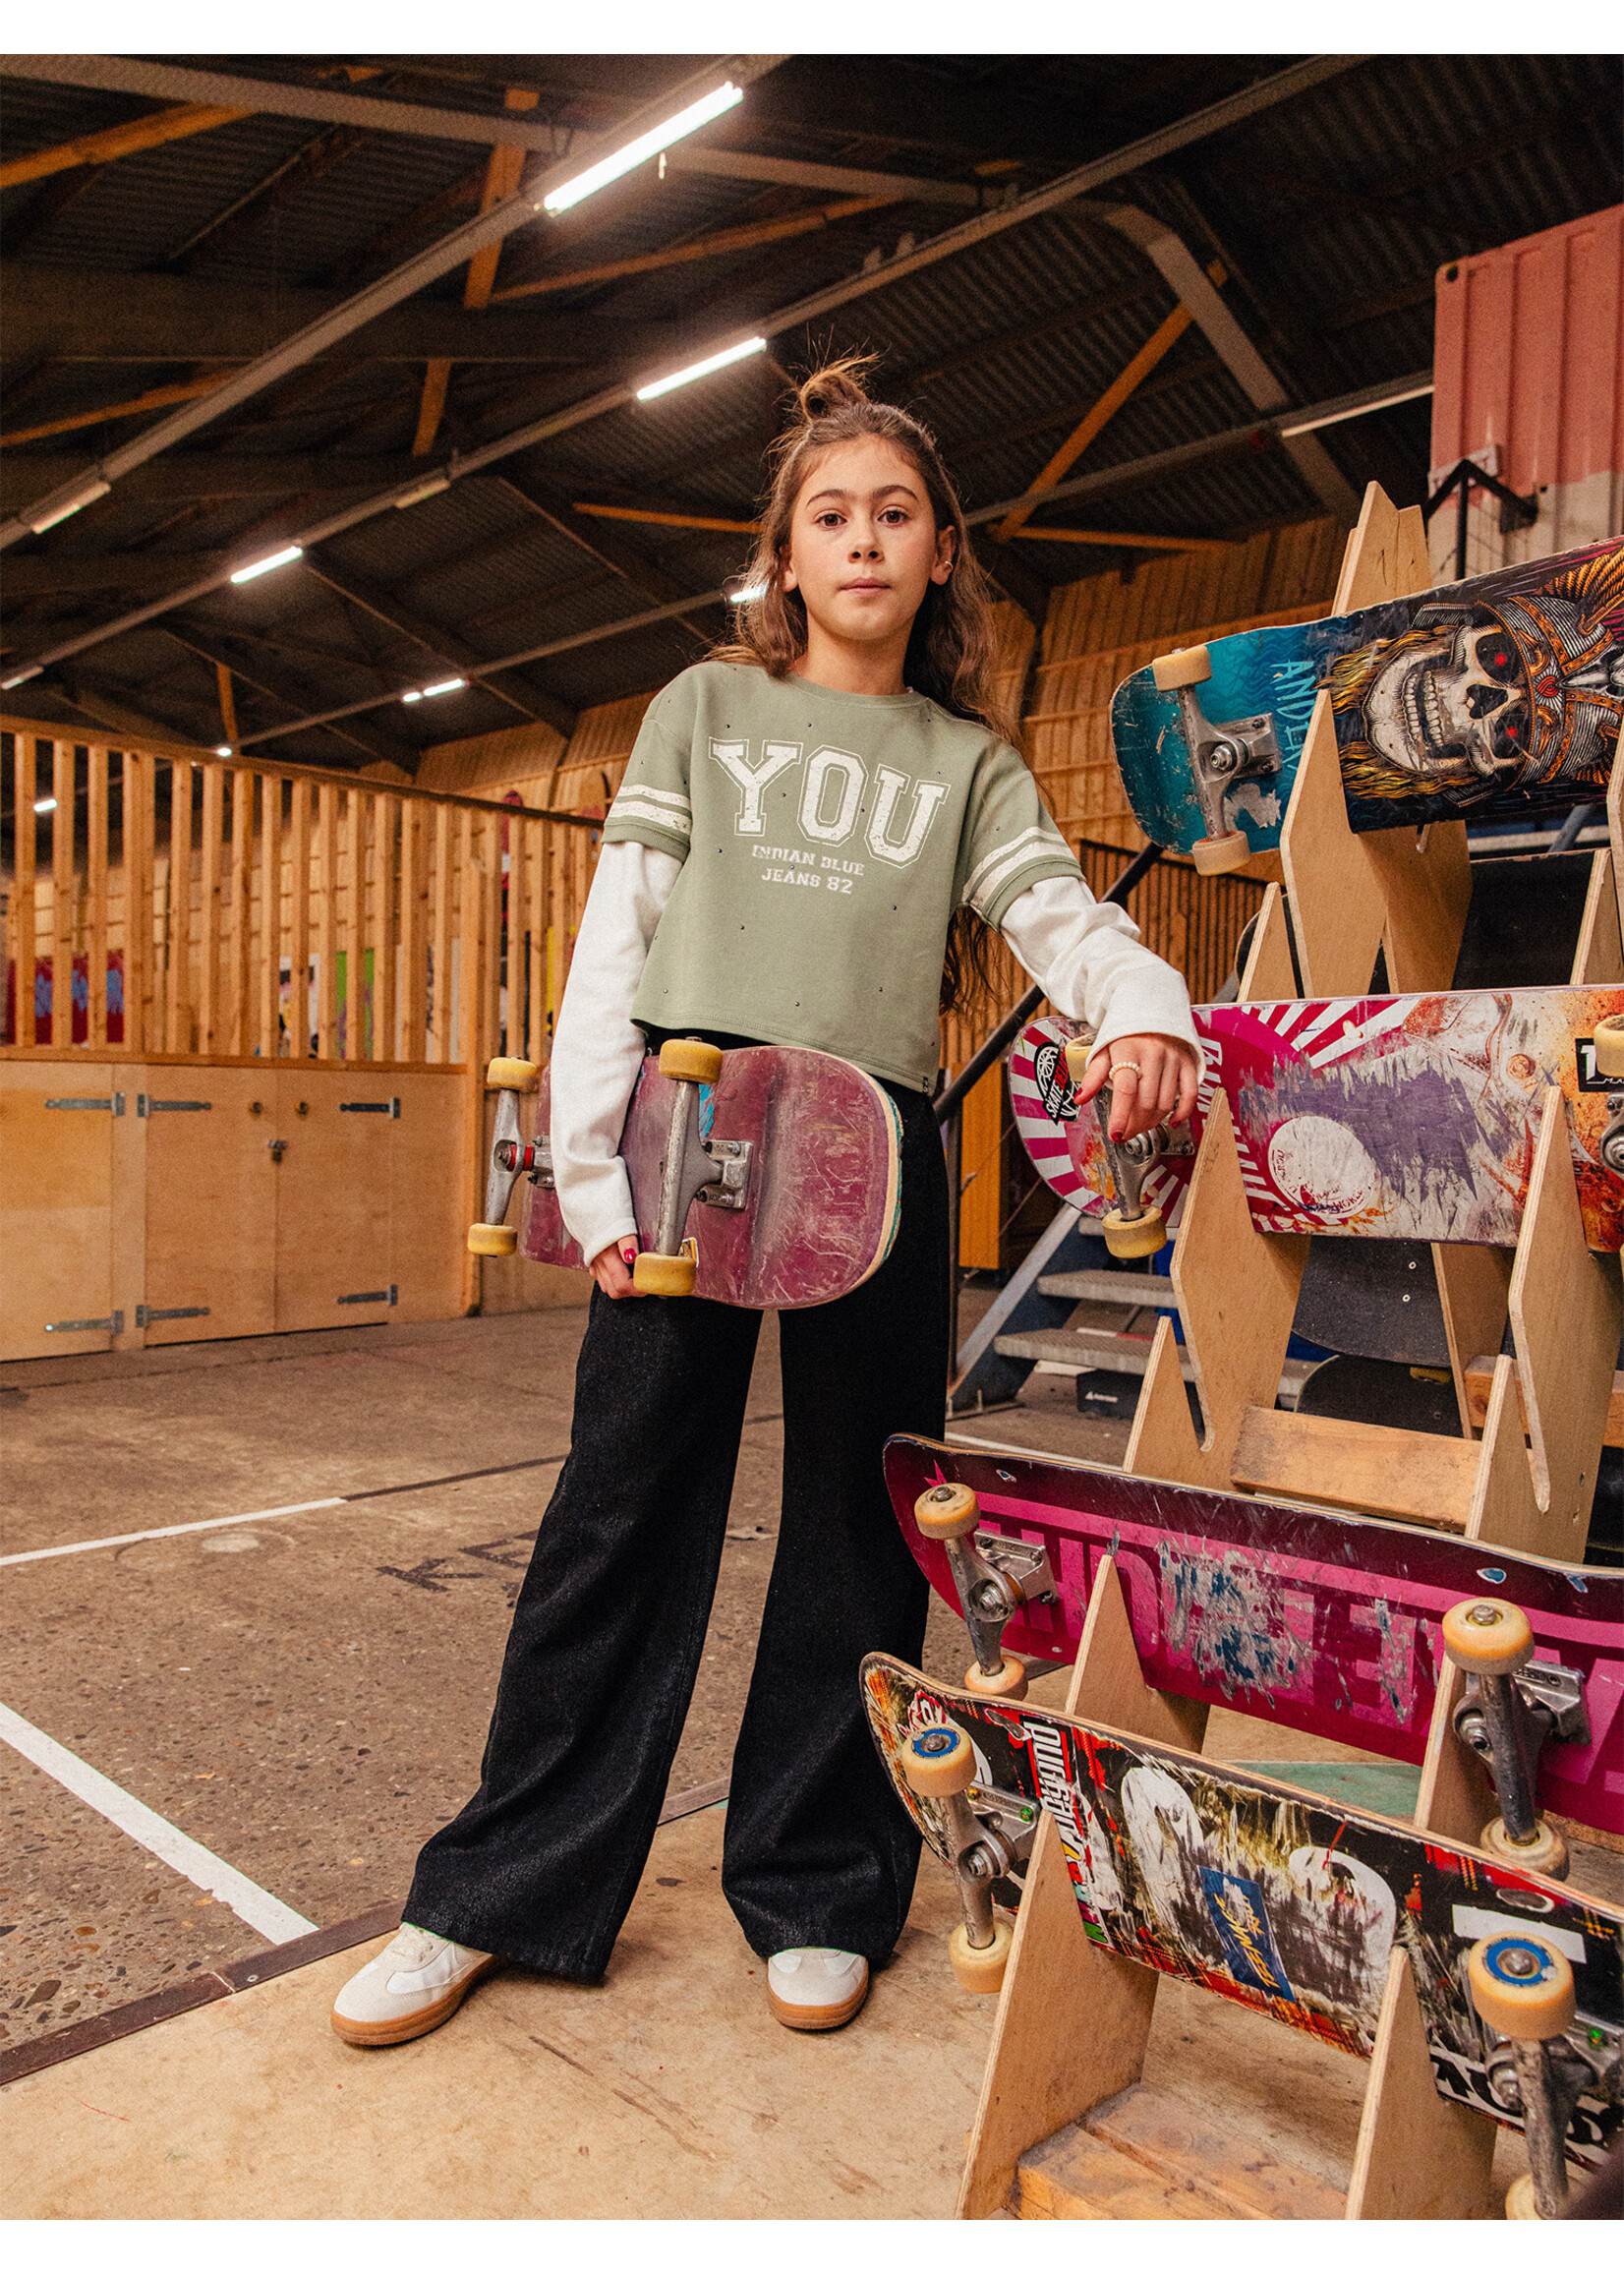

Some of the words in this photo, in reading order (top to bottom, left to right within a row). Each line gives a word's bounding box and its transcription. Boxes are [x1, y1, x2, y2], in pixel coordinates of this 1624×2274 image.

[709, 736, 951, 869] YOU
[751, 845, 816, 866] INDIAN
[820, 855, 865, 877] BLUE
[761, 867, 822, 888] JEANS
[826, 875, 853, 895] 82
